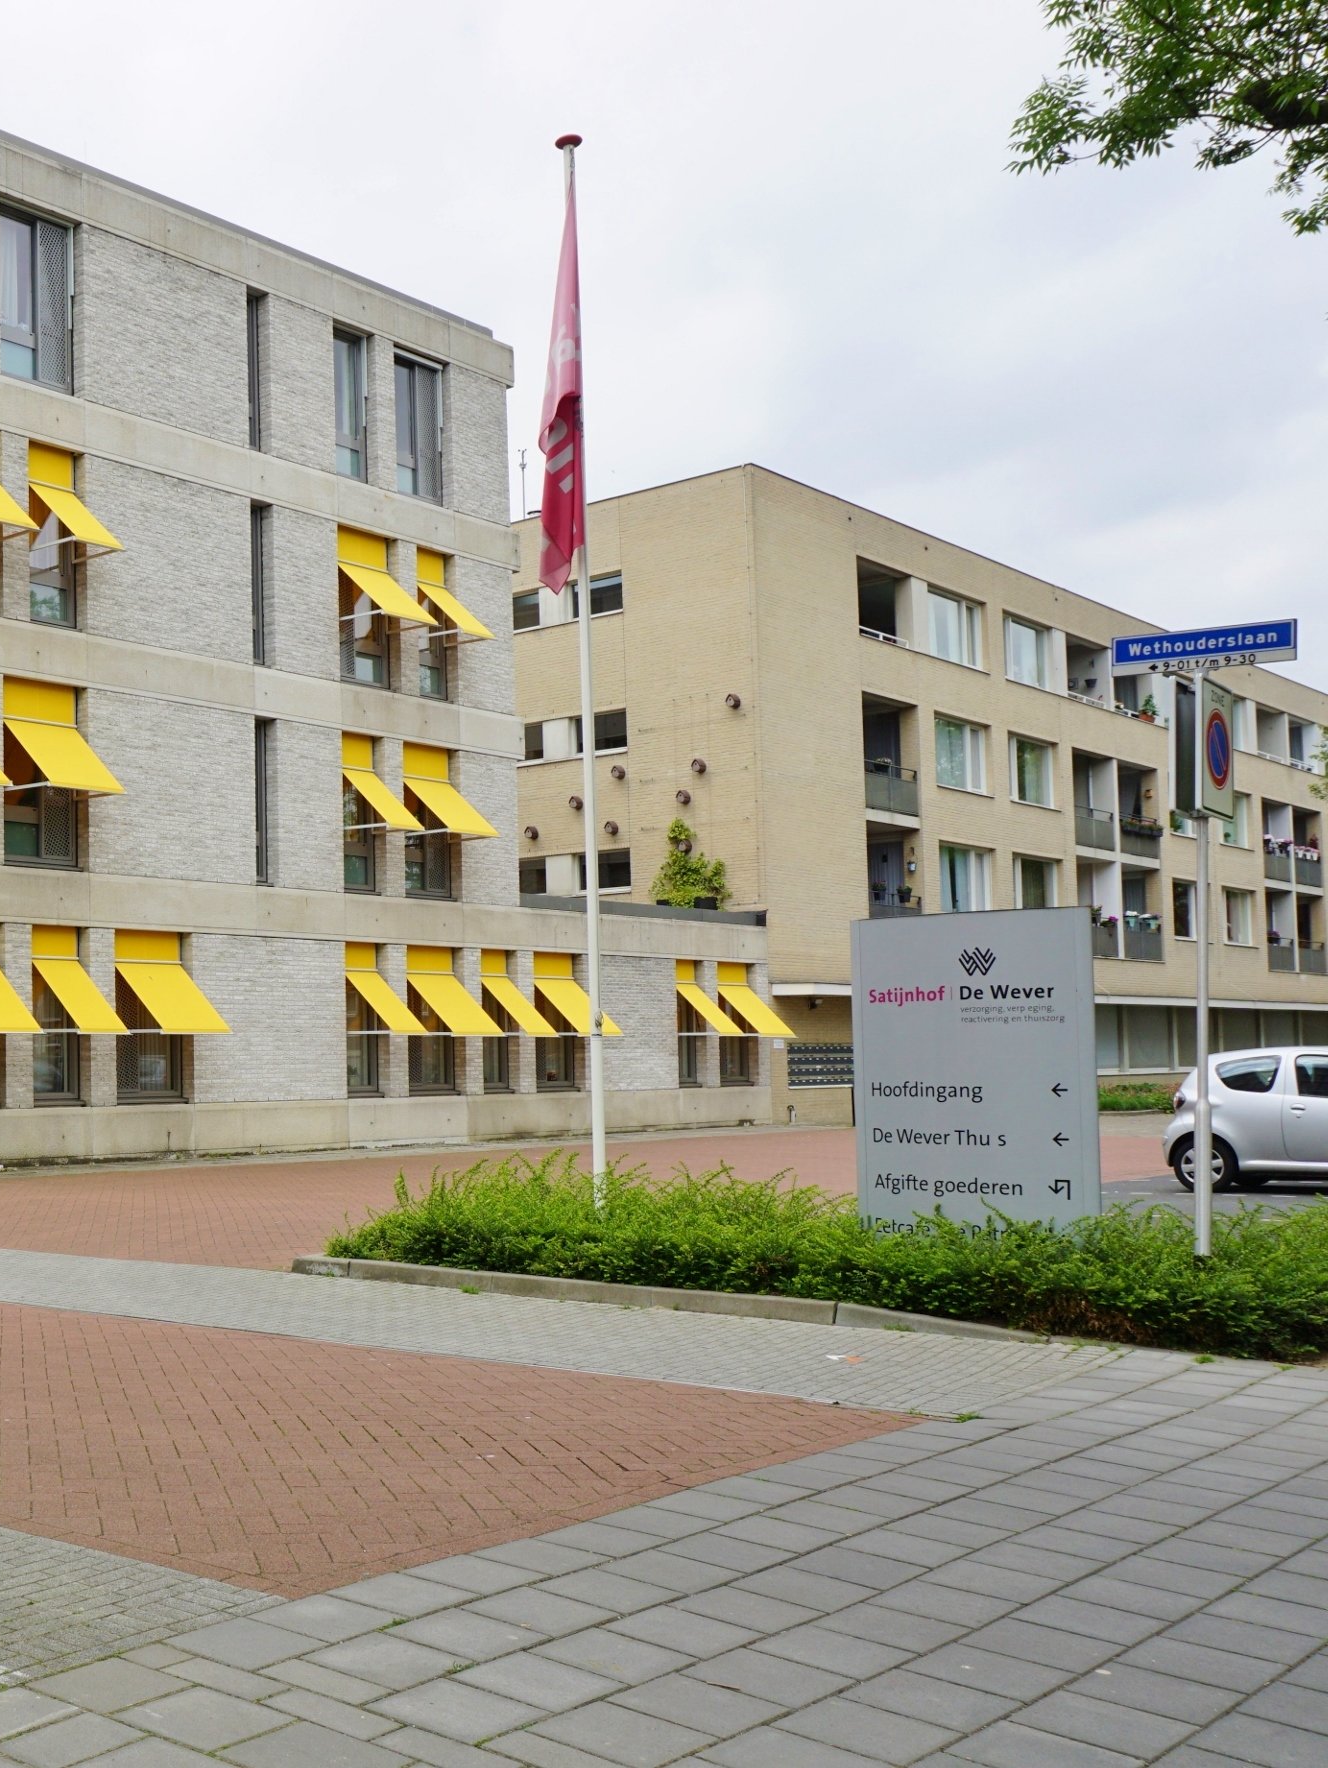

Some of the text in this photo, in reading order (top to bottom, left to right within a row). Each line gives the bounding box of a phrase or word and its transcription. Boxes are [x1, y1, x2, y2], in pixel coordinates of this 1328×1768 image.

[1128, 631, 1277, 657] Wethouderslaan
[1162, 653, 1256, 671] 9-01 t/m 9-30
[868, 984, 1054, 1006] Satijnhof De Wever
[961, 1015, 1009, 1024] reactivering
[1024, 1014, 1065, 1023] thuiszorg
[1006, 1004, 1055, 1014] verpeging,
[871, 1081, 983, 1103] Hoofdingang
[873, 1127, 1007, 1147] De Wever Thus
[874, 1173, 1023, 1197] Afgifte goederen
